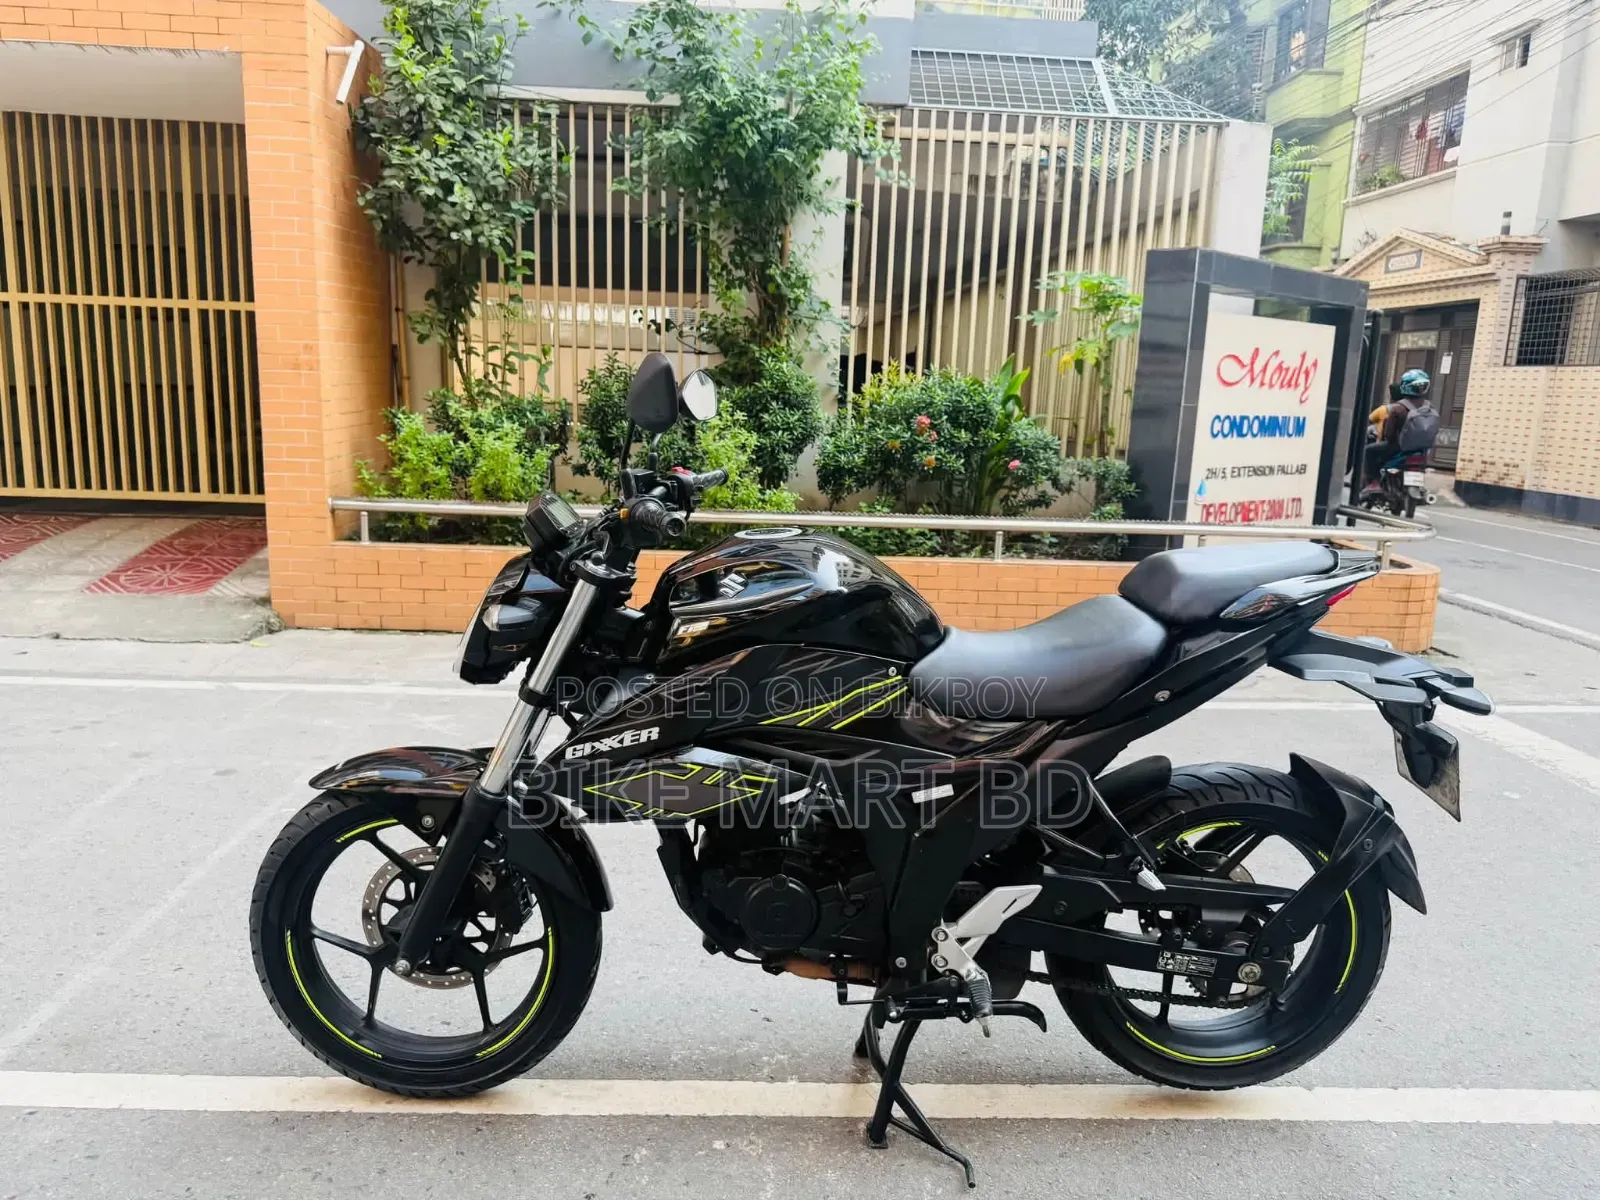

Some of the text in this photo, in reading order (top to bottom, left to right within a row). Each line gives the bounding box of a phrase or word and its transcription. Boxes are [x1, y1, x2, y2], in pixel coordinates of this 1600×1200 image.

[1216, 347, 1318, 404] Mouly
[1210, 414, 1307, 439] CONDOMINIUM
[1230, 465, 1275, 479] EXTENSION
[565, 726, 660, 760] GIXXER
